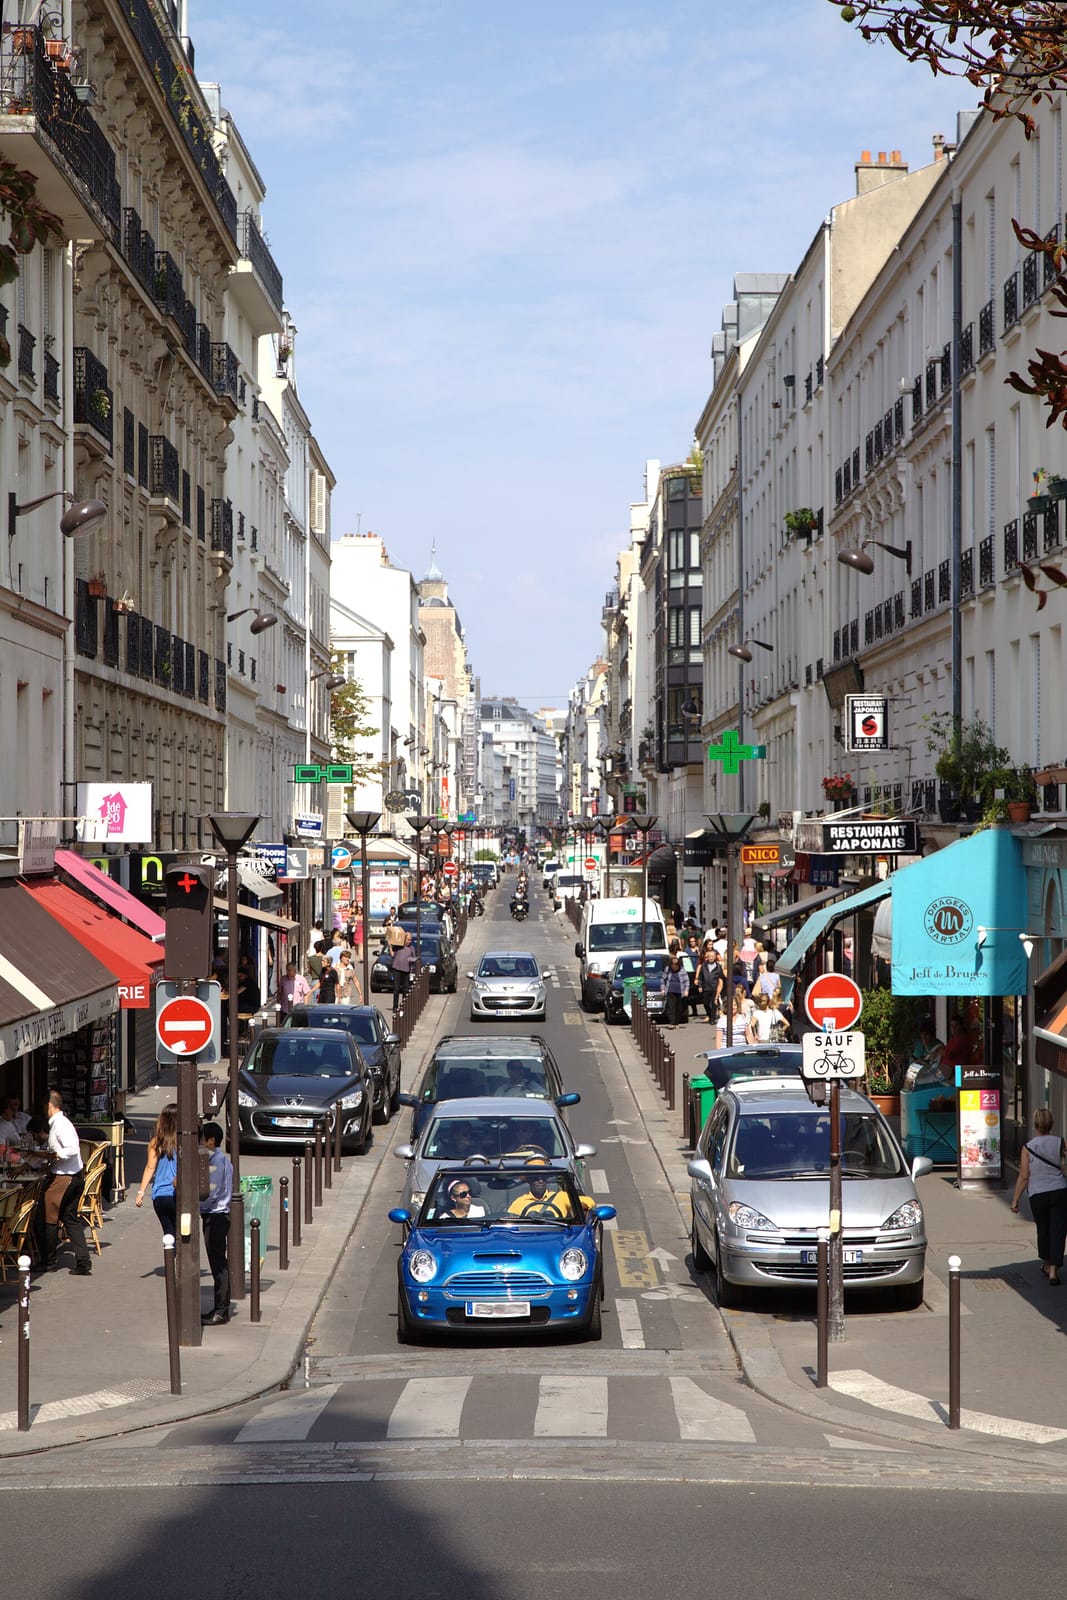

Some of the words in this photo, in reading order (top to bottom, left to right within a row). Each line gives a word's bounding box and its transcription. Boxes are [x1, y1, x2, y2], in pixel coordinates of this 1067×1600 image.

[830, 825, 907, 839] RESTAURANT
[832, 838, 906, 850] JAPONAIS
[257, 847, 286, 857] Phone
[927, 899, 970, 917] DRAGEES
[927, 926, 971, 943] MARTIAL
[909, 967, 932, 981] Jeff
[933, 970, 942, 978] de
[946, 965, 988, 982] Bruges
[814, 1035, 853, 1047] SAUF
[982, 1093, 997, 1104] 23
